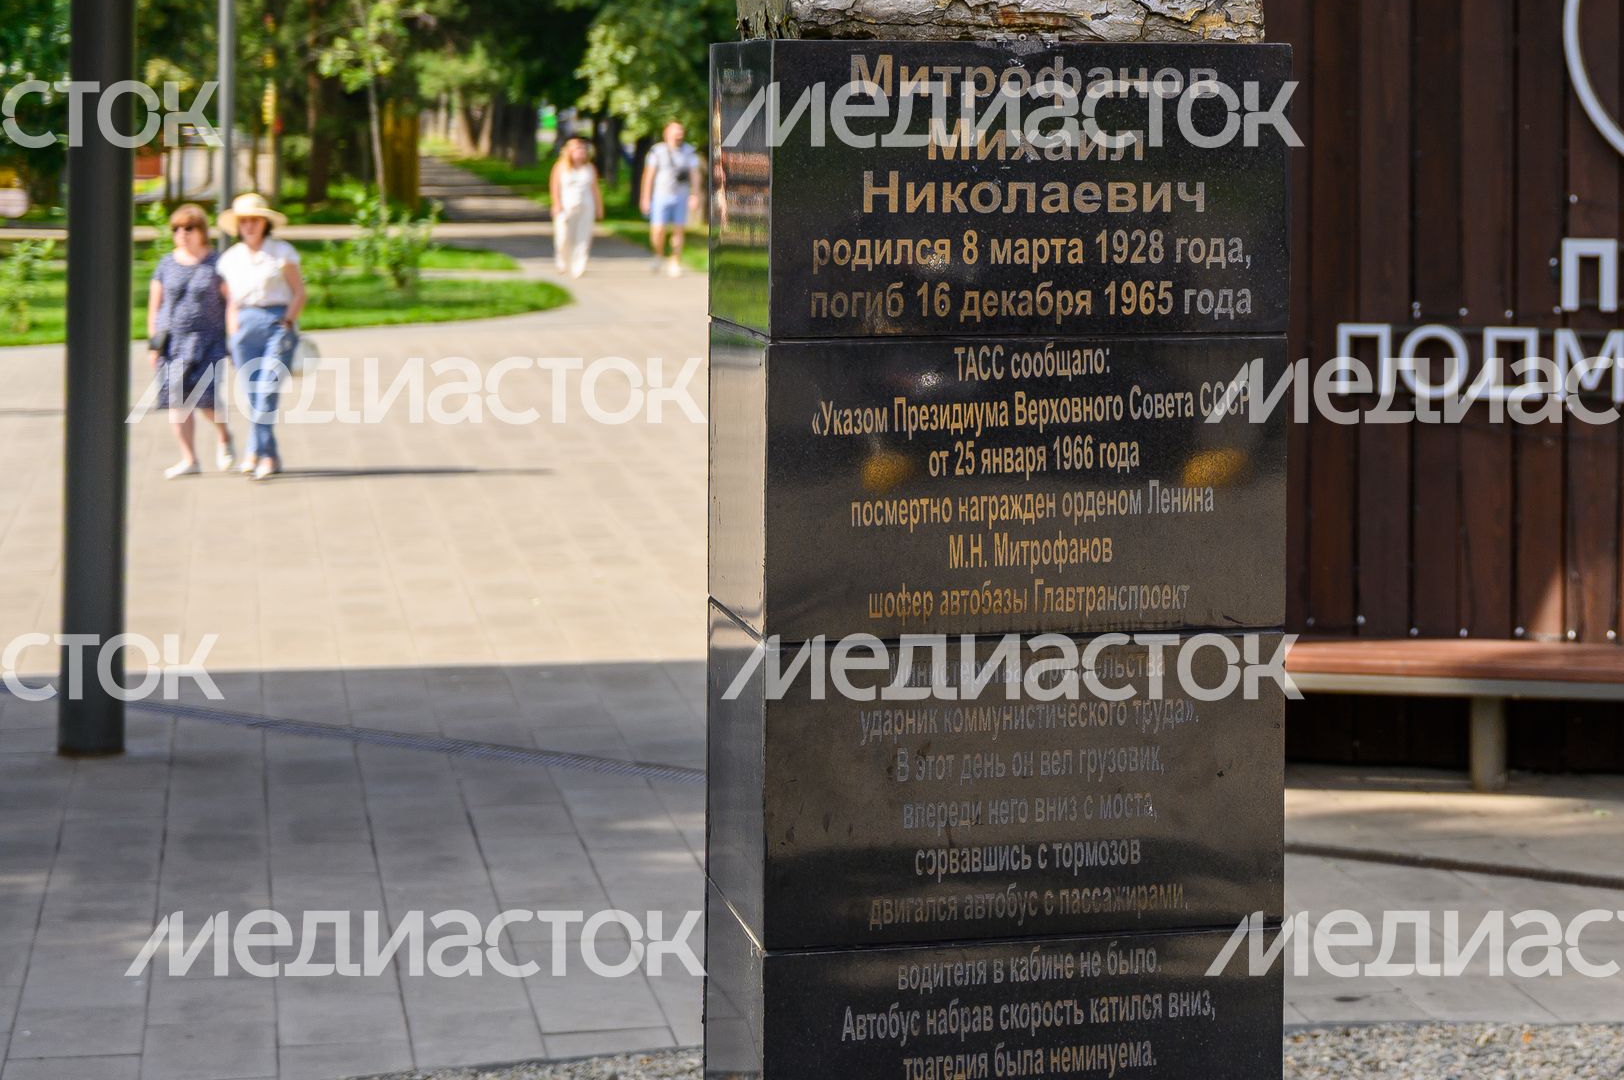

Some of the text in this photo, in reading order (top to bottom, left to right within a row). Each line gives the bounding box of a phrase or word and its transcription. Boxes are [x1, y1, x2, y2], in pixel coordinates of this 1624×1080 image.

[850, 54, 1219, 108] Митрофанов
[927, 118, 1144, 161] Михаил
[863, 170, 1206, 213] Николаевич
[813, 229, 1251, 275] родился 8 марта 1928 года,
[810, 280, 1252, 324] погиб 16 декабря 1965 года
[954, 342, 1110, 382] ТАСС сообщало:
[811, 380, 1249, 440] «Указом Президиума Верховного Совета СССР
[929, 434, 1140, 481] от 25 января 1966 года
[851, 479, 1214, 534] посмертно награжден орденом Ленина
[949, 530, 1113, 574] М.Н. Митрофанов
[868, 578, 1190, 627] шофер автобазы Главтранспроект
[860, 708, 938, 745] ударник
[943, 700, 1128, 742] коммунистического
[896, 744, 1165, 786] В этот день он вел грузовик,
[903, 799, 983, 836] впереди
[988, 797, 1029, 825] него
[1035, 796, 1078, 823] вниз
[1083, 797, 1094, 820] с
[914, 838, 1141, 883] сорвавшись с тормозов
[869, 894, 958, 931] двигался
[963, 882, 1038, 926] автобус
[1044, 887, 1054, 915] с
[898, 940, 1162, 995] водителя в кабине не было.
[841, 989, 1216, 1047] Автобус набрав скорость катился вниз,
[902, 1040, 1158, 1080] трагедия была неминуема.
